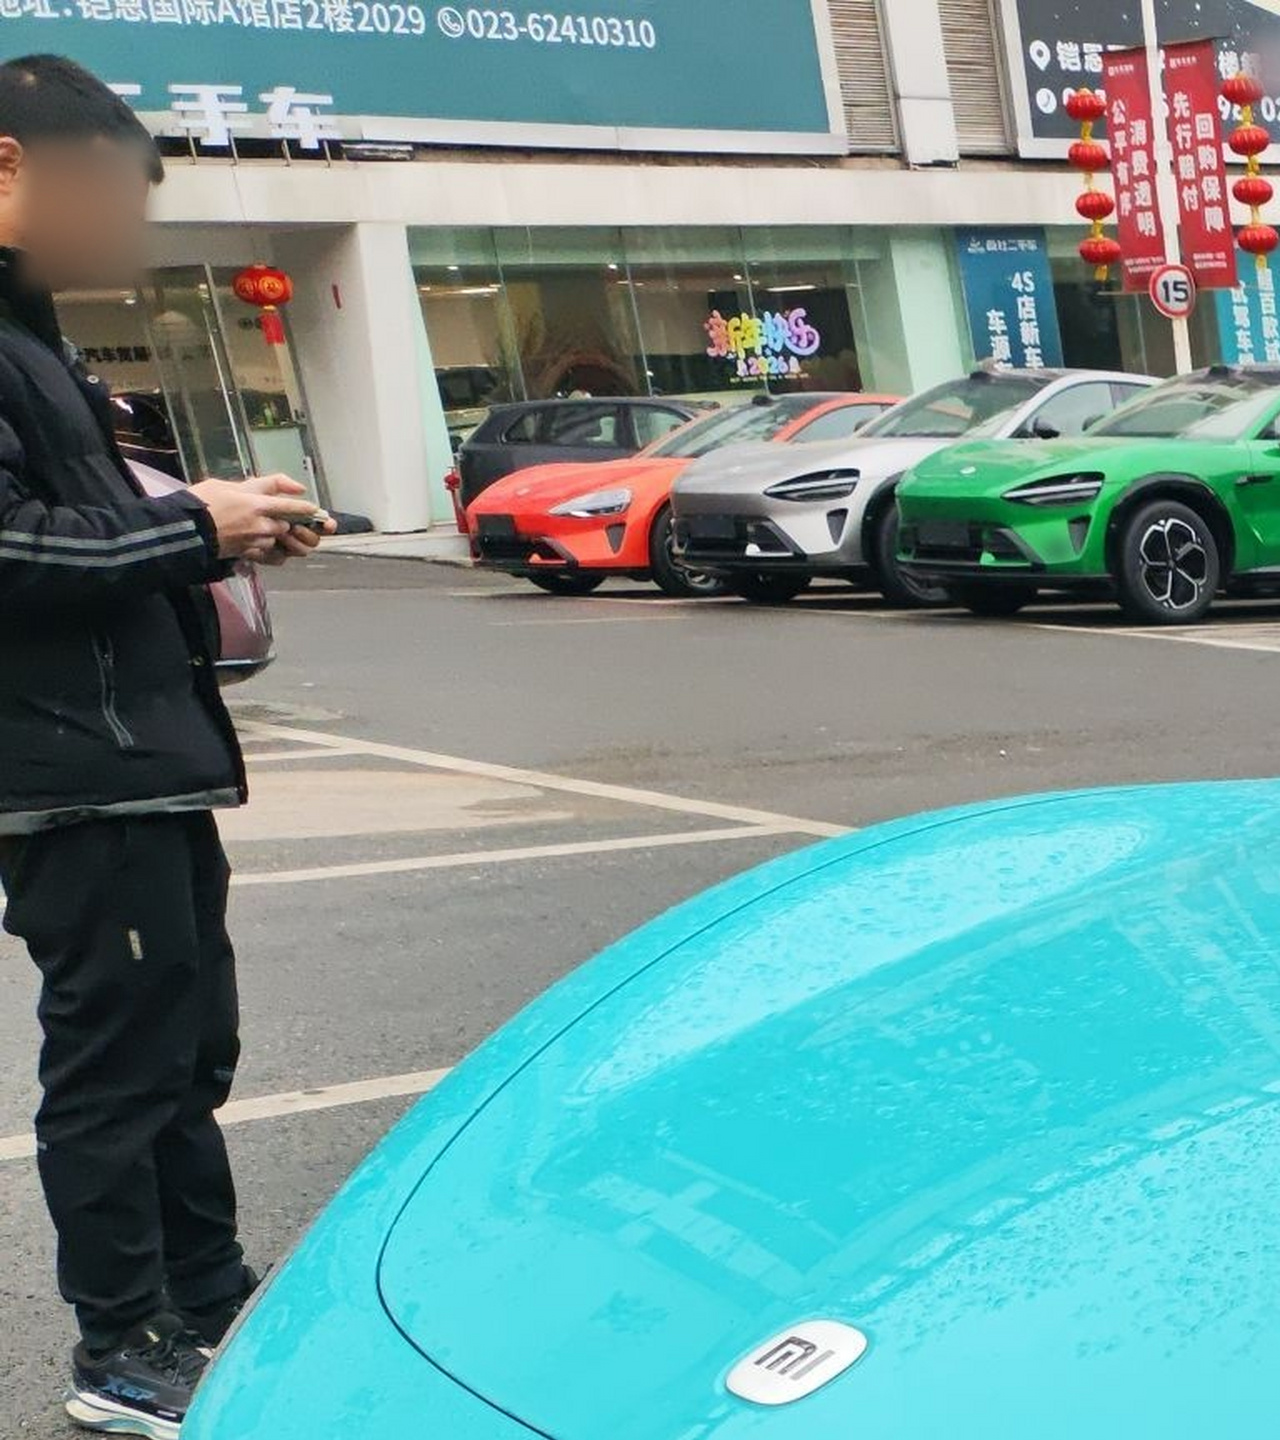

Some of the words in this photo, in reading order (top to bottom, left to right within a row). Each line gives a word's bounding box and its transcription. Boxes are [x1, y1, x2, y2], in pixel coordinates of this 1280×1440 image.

[466, 9, 656, 48] 023-62410310
[1112, 98, 1132, 217] 公平有序
[1130, 119, 1157, 238] 消费透明
[1173, 90, 1199, 211] 先行赔付
[1195, 112, 1226, 233] 回购保障
[1161, 280, 1190, 303] 15
